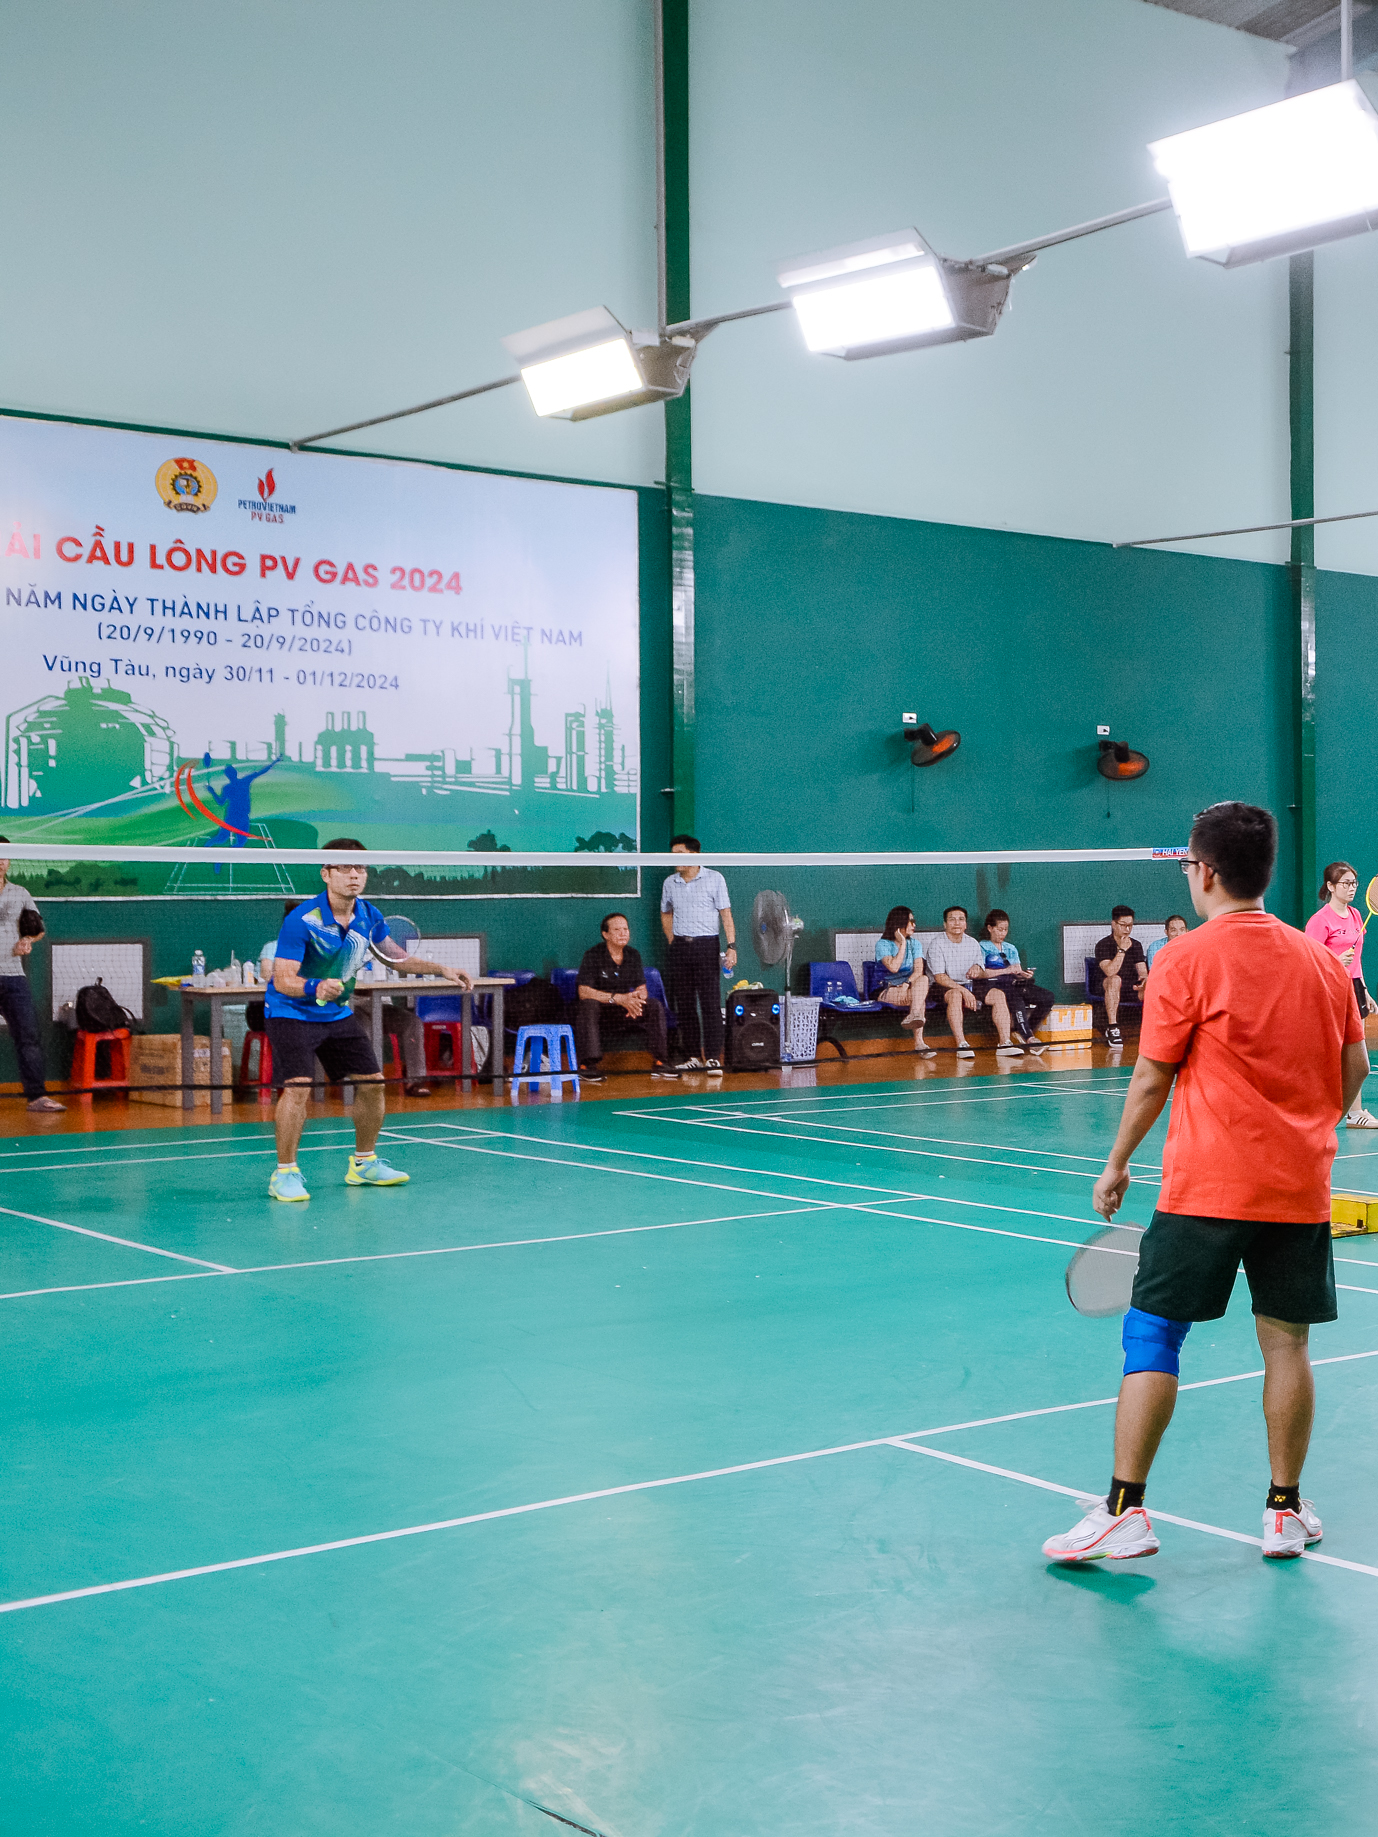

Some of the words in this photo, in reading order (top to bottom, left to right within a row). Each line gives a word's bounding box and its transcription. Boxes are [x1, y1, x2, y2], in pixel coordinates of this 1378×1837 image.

[237, 499, 296, 514] PETROVIETNAM
[251, 511, 263, 522] PV
[265, 512, 284, 524] GAS
[0, 521, 41, 560] ẢI
[55, 524, 135, 567] CẦU
[149, 538, 247, 576] LÔNG
[259, 553, 301, 581] PV
[312, 558, 379, 588] GAS
[389, 565, 463, 595] 2024
[5, 583, 62, 610] NĂM
[71, 589, 138, 615] NGÀY
[146, 594, 228, 621] THÀNH
[237, 600, 280, 628] LẬP
[286, 599, 347, 630] TỔNG
[354, 609, 413, 635] CÔNG
[419, 618, 444, 637] TY
[450, 617, 485, 640] KHÍ
[490, 620, 534, 646] VIỆT
[540, 627, 583, 647] NAM
[97, 621, 218, 646] (20/9/1990
[240, 632, 352, 656] 20/9/2024)
[42, 654, 102, 679] Vũng
[109, 658, 156, 680] Tàu,
[165, 662, 216, 685] ngày
[223, 665, 274, 684] 30/11
[296, 669, 400, 690] 01/12/2024
[1162, 848, 1174, 856] HAI
